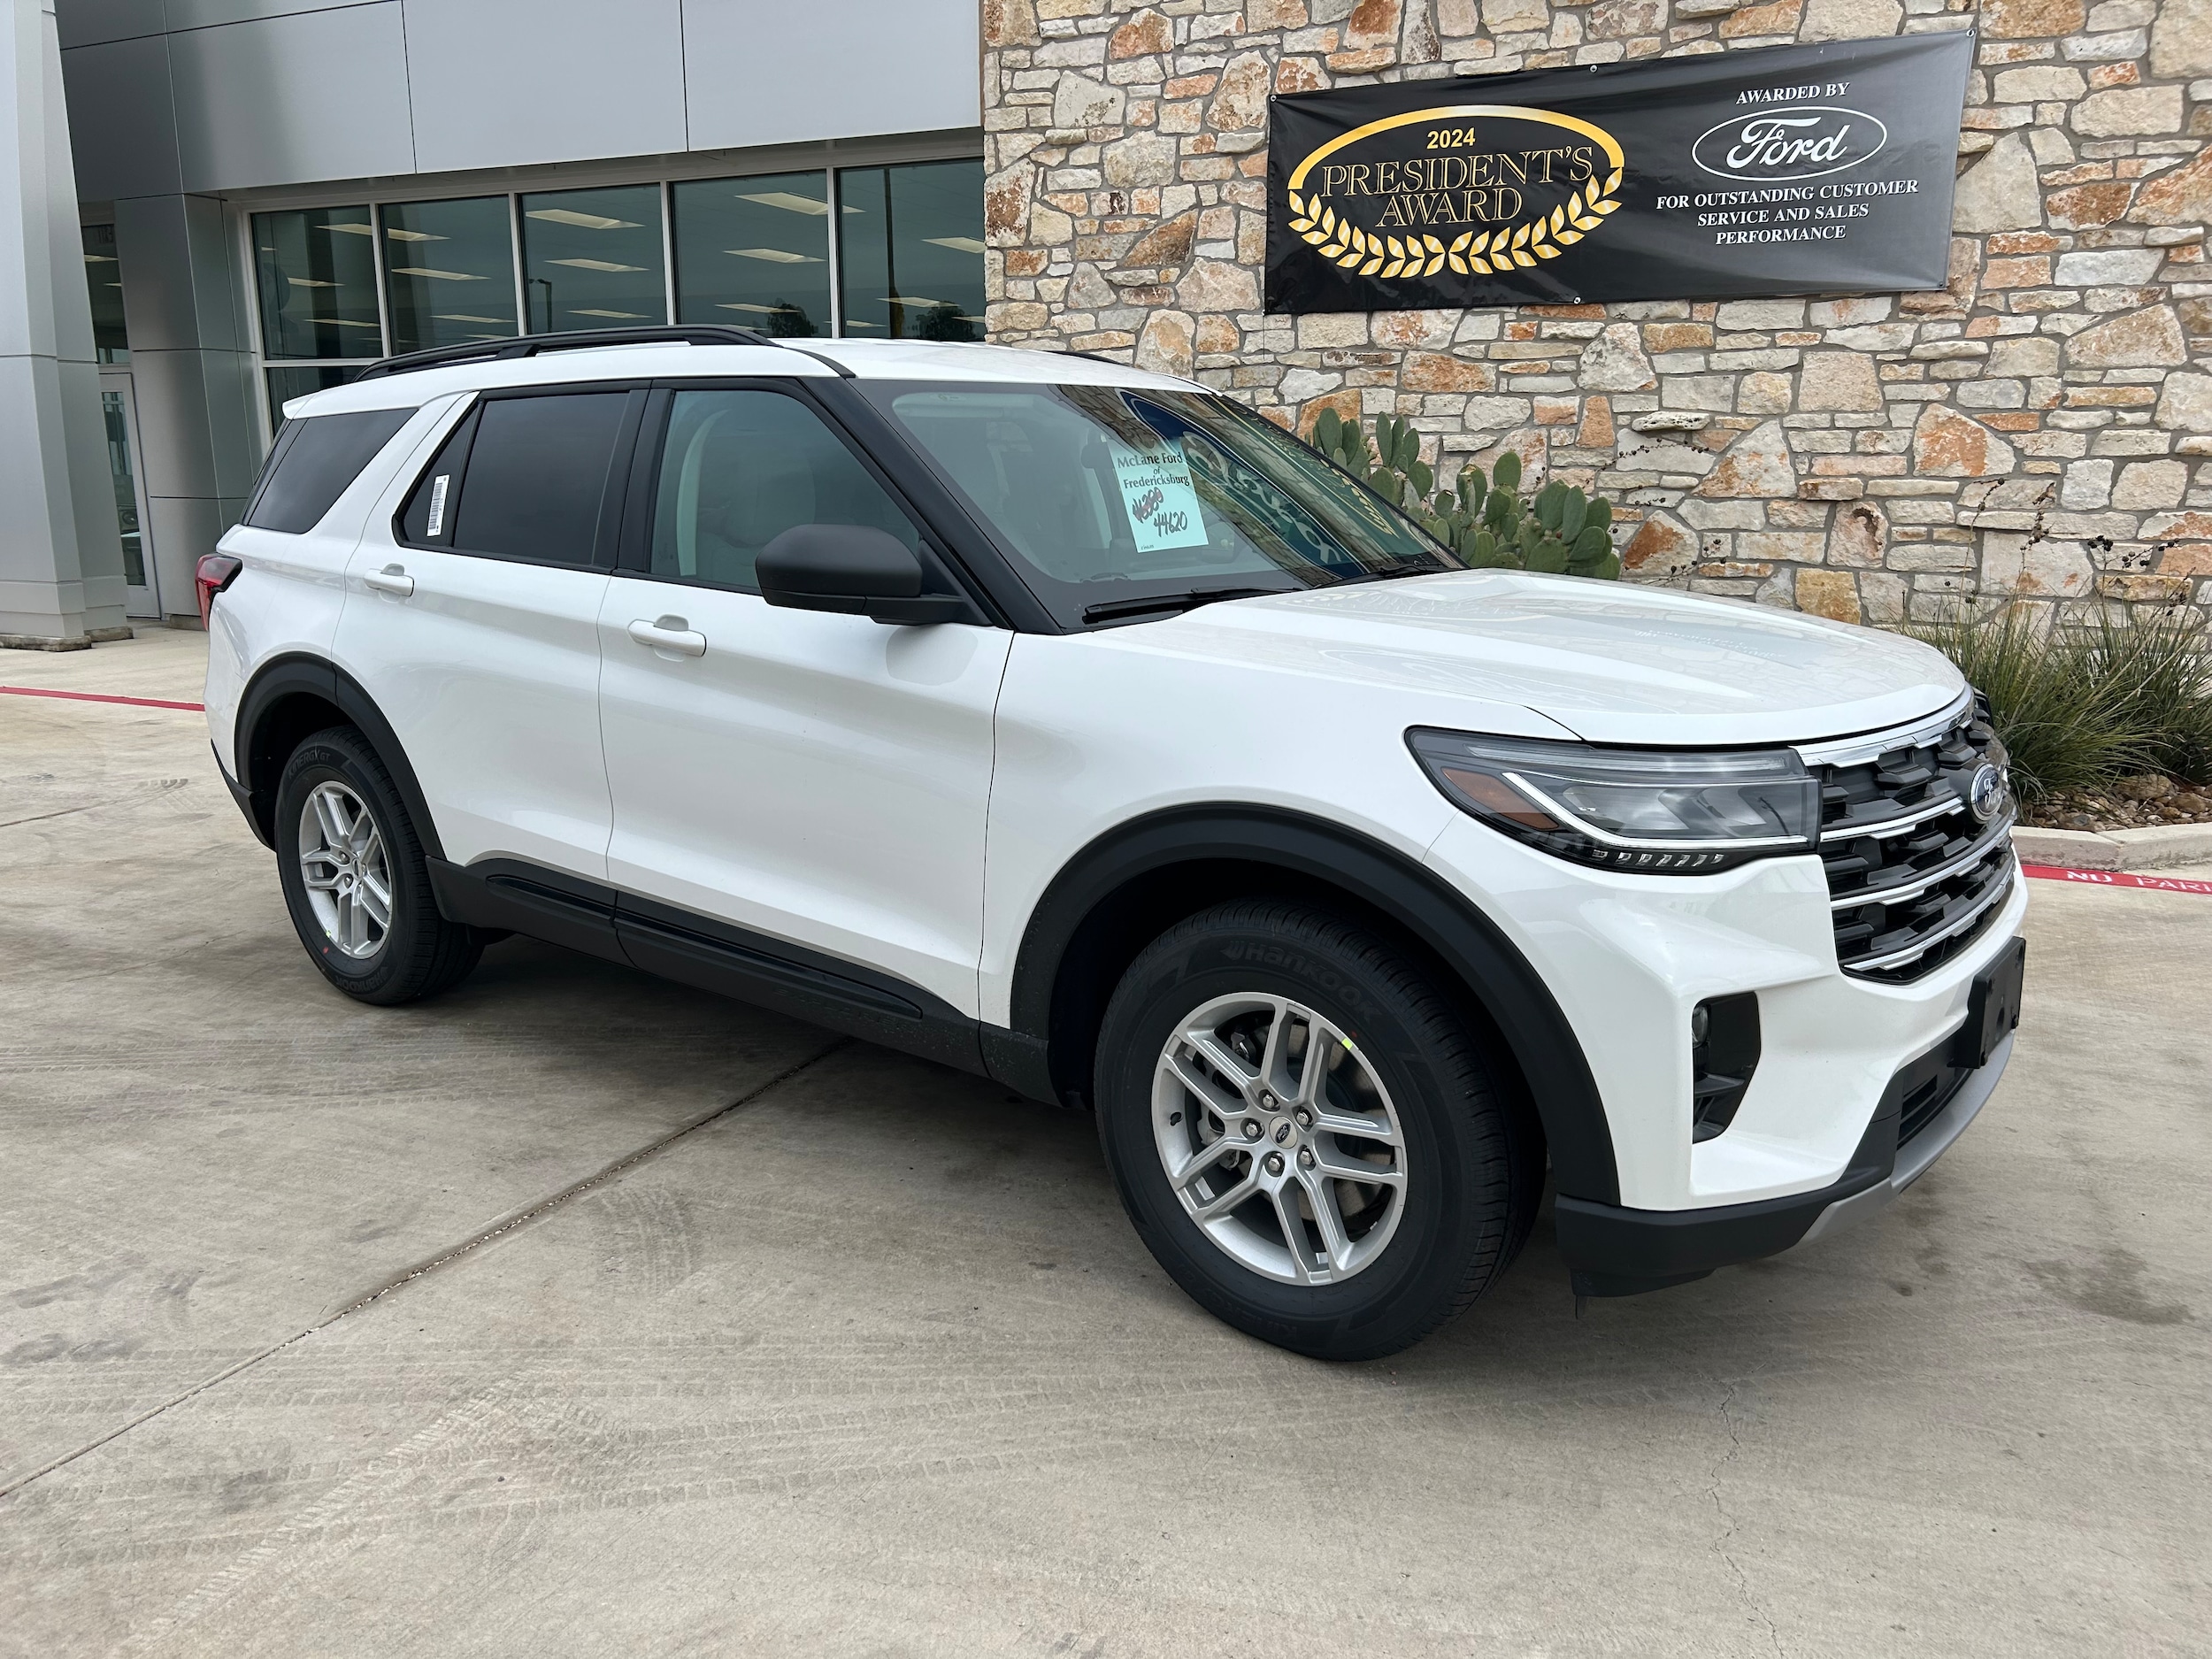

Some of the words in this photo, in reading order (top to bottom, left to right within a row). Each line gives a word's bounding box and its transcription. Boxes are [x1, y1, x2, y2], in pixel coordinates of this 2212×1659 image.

[1736, 85, 1821, 104] AWARDED
[1825, 82, 1850, 97] BY
[1426, 127, 1476, 150] 2024
[1726, 116, 1850, 168] Ford
[1321, 146, 1594, 197] PRESIDENT'S
[1656, 196, 1690, 210] FOR
[1694, 186, 1814, 208] OUTSTANDING
[1819, 180, 1919, 200] CUSTOMER
[1376, 188, 1524, 228] AWARD
[1697, 209, 1770, 227] SERVICE
[1774, 207, 1810, 222] AND
[1814, 203, 1870, 220] SALES
[1716, 225, 1847, 245] PERFORMANCE
[1117, 454, 1160, 469] McLane
[1161, 451, 1184, 464] Ford
[1153, 466, 1161, 475] of
[1123, 473, 1190, 489] Fredericksburg
[1153, 511, 1188, 538] 44620
